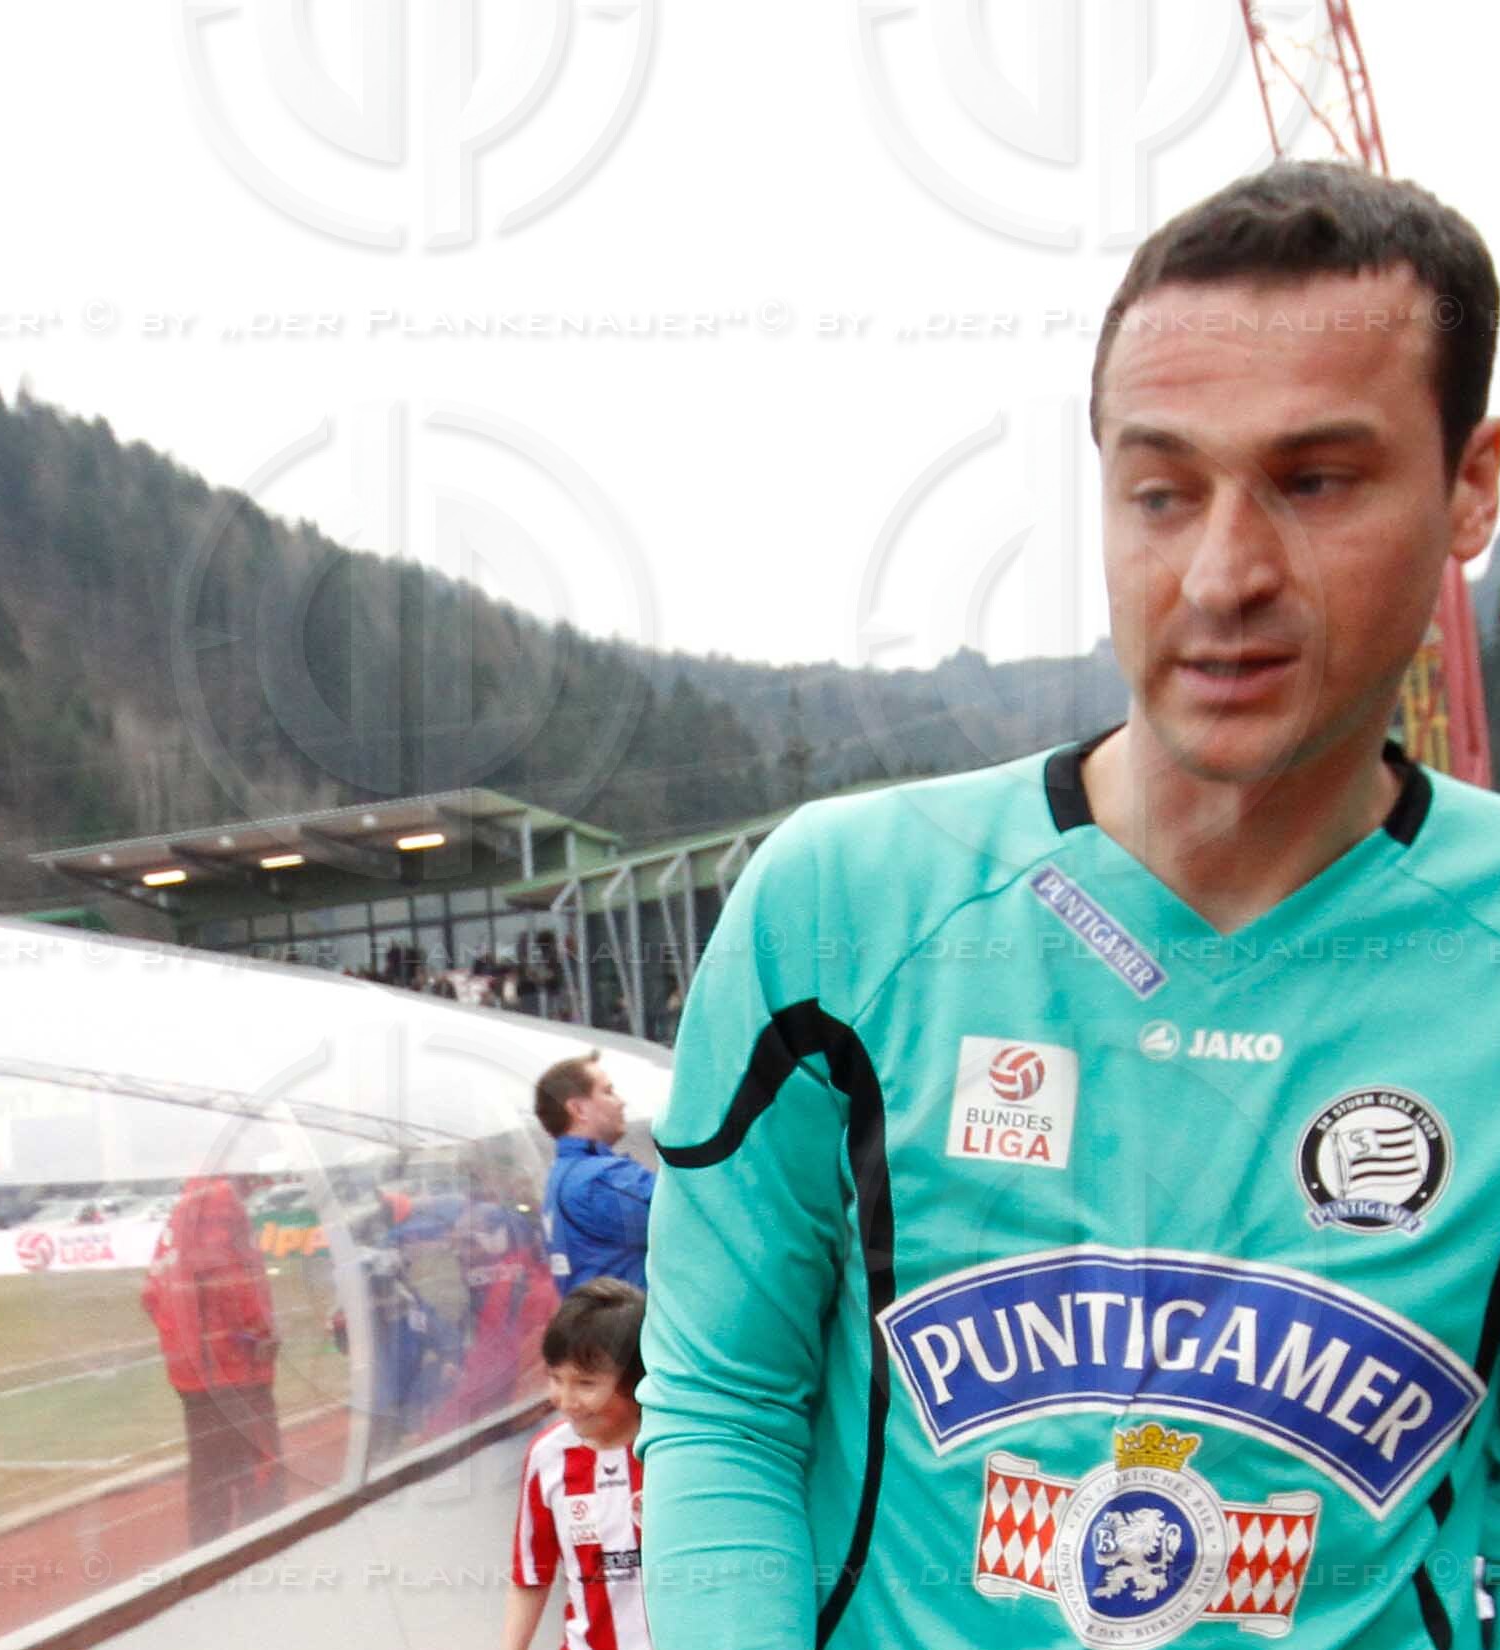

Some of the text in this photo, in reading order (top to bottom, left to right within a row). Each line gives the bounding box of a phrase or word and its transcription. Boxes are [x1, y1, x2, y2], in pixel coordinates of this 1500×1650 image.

[1038, 873, 1156, 988] PUNTIGAMER
[1188, 1030, 1283, 1062] JAKO
[966, 1107, 1053, 1133] BUNDES
[962, 1126, 1051, 1162] LIGA
[911, 1292, 1433, 1464] PUNTIGAMER
